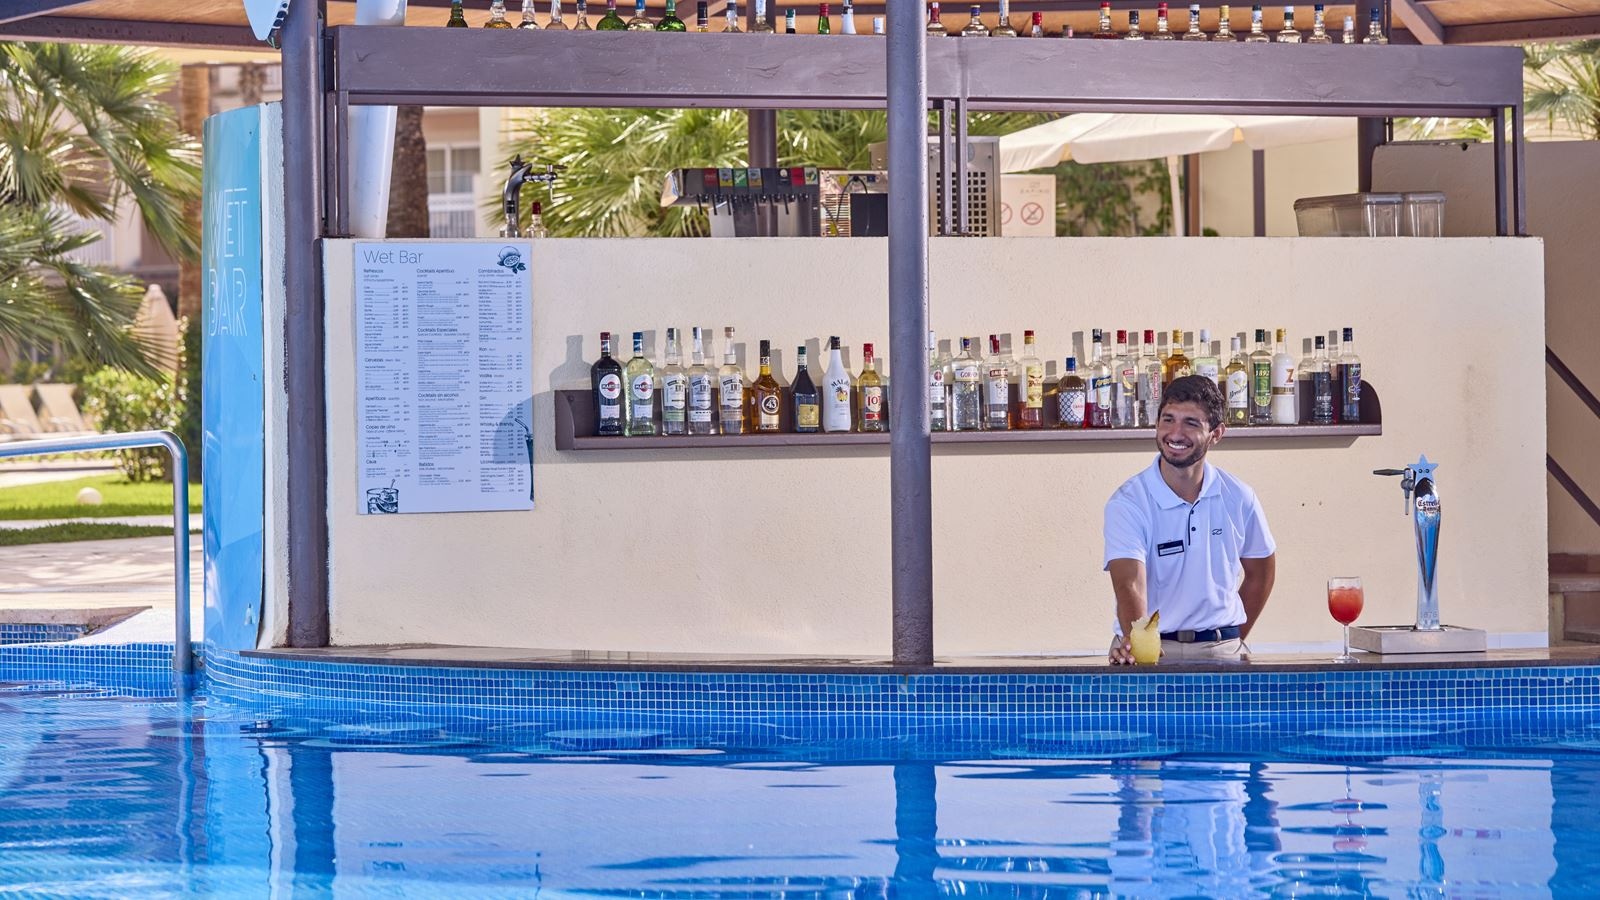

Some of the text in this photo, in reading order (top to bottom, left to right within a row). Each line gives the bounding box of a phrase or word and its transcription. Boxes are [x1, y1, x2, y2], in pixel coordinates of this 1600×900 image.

[209, 188, 247, 257] WET
[363, 250, 423, 264] Wet Bar
[208, 268, 248, 336] BAR
[766, 400, 777, 409] 43
